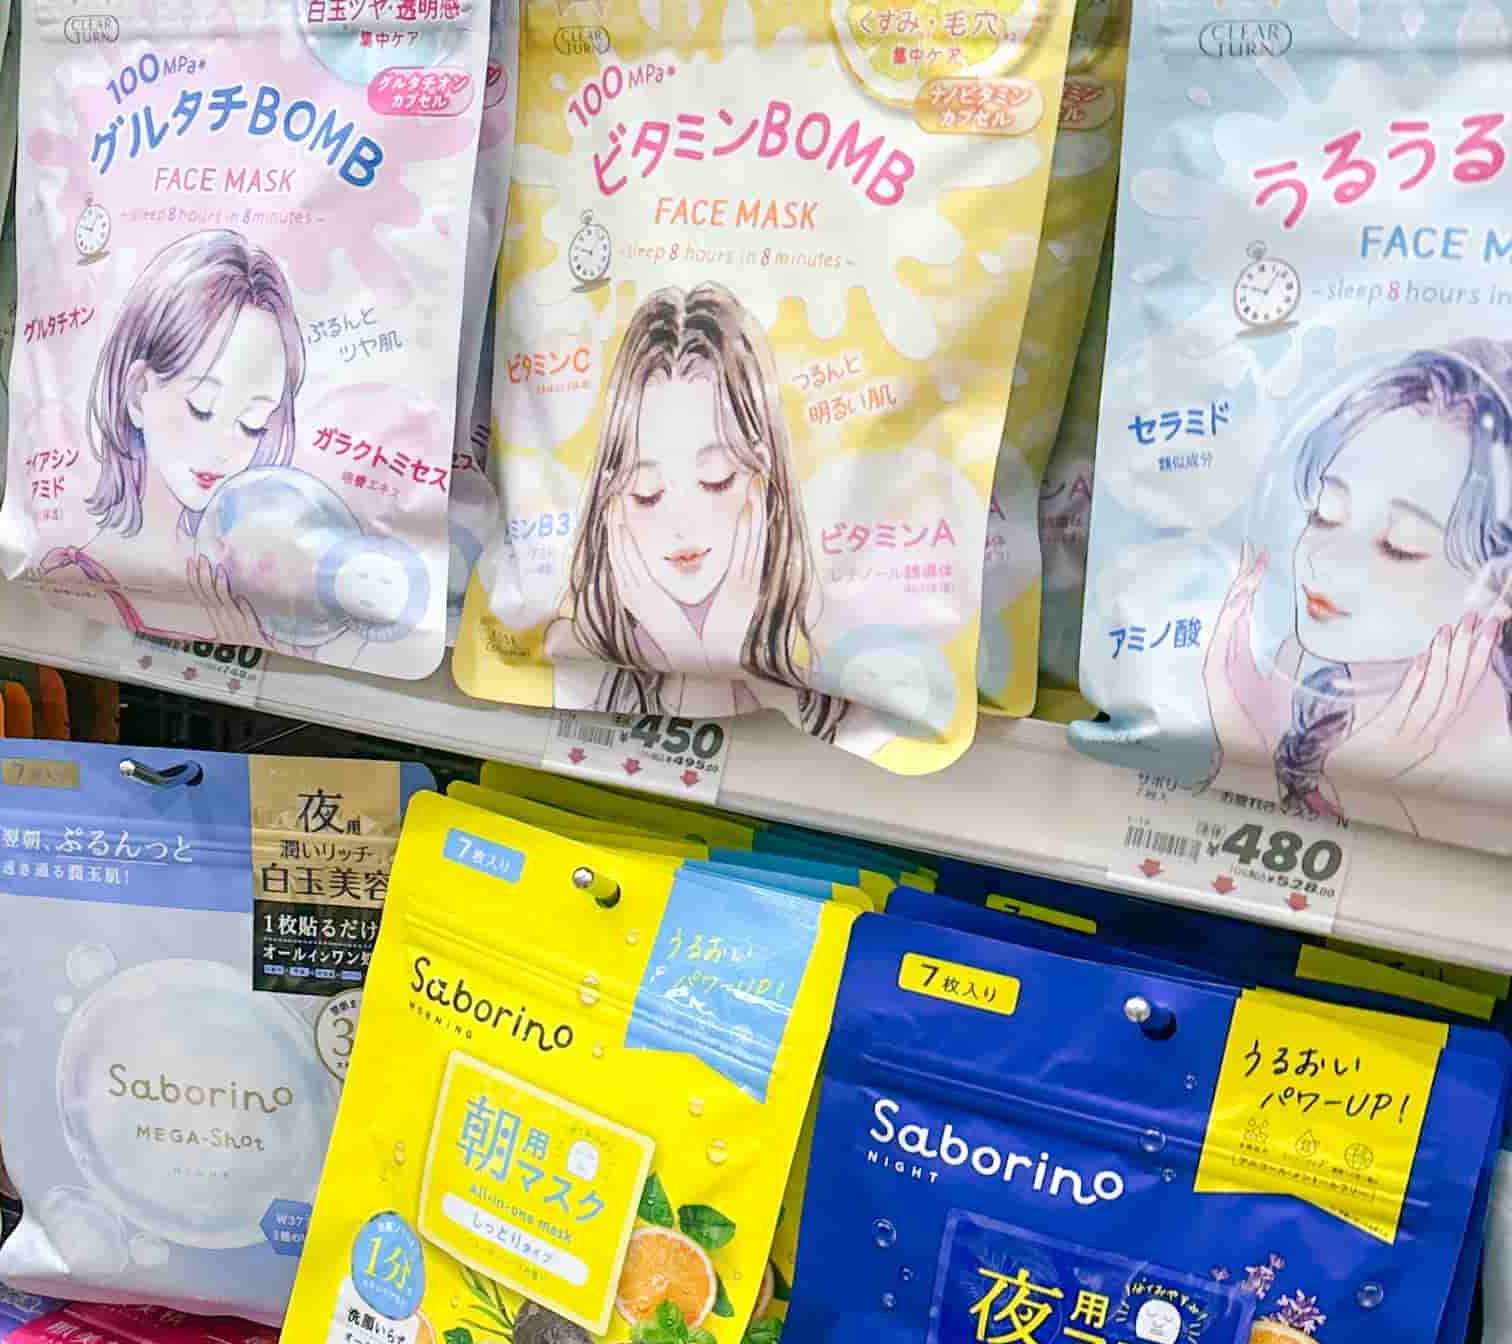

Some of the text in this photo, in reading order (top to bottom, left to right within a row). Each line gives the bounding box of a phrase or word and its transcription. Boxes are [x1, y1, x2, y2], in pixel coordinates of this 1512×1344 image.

[90, 84, 384, 189] グルタチBOMB
[593, 99, 917, 208] ビタミンBOMB
[154, 166, 296, 194] FACE MASK
[1252, 112, 1506, 230] うるうる
[655, 197, 820, 230] FACE MASK
[1360, 224, 1468, 259] FACE
[1128, 399, 1231, 445] セラミド
[313, 425, 449, 492] ガラクトミセス
[820, 524, 956, 556] ビタミンA
[1107, 616, 1202, 659] アミノ酸
[411, 955, 575, 1053] Saborino
[920, 963, 999, 1005] 7枚入り
[108, 1063, 295, 1114] Saborino
[870, 1098, 1125, 1206] Saborino
